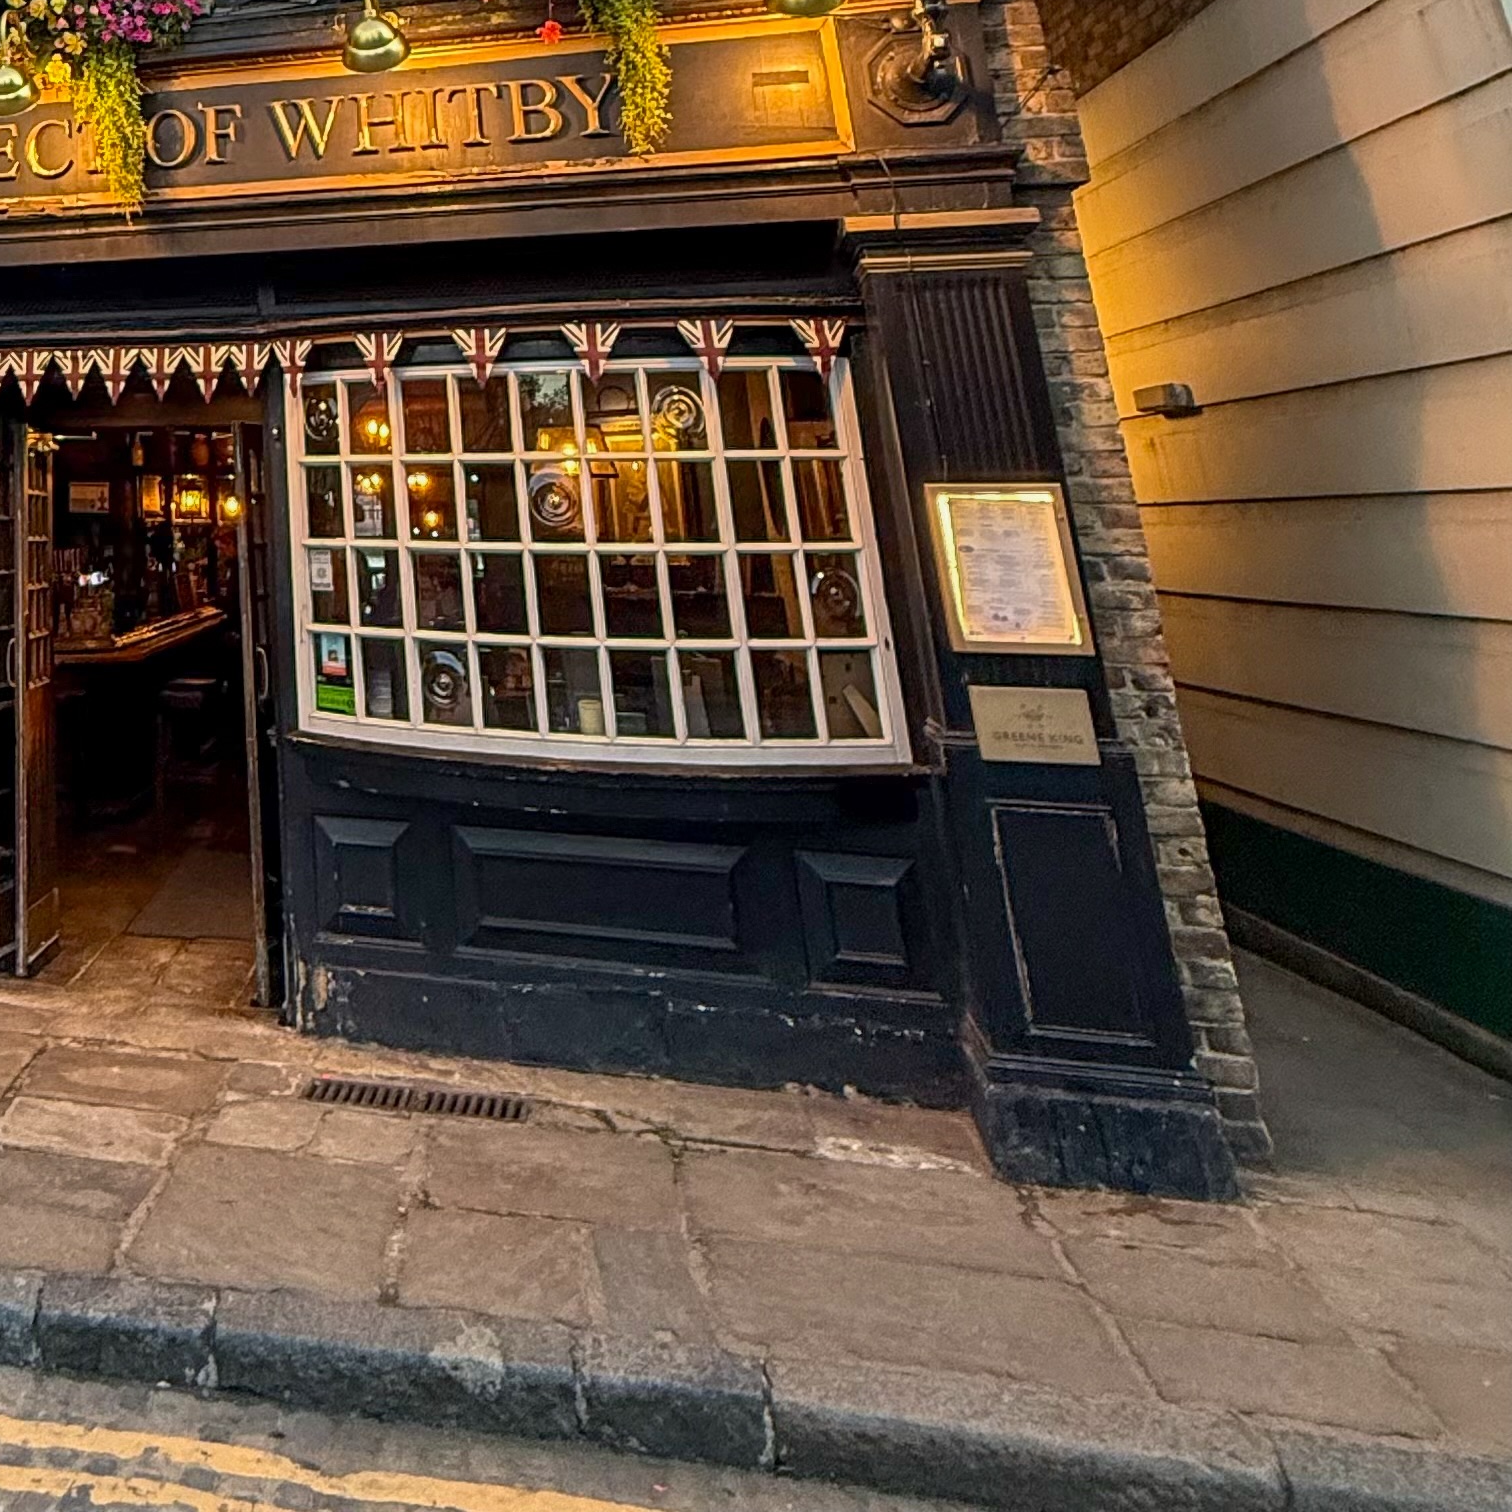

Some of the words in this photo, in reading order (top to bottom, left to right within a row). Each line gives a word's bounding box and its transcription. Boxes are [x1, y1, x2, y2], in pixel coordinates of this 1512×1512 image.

[146, 102, 242, 168] OF
[269, 73, 618, 160] WHITBY
[1048, 734, 1084, 745] KING
